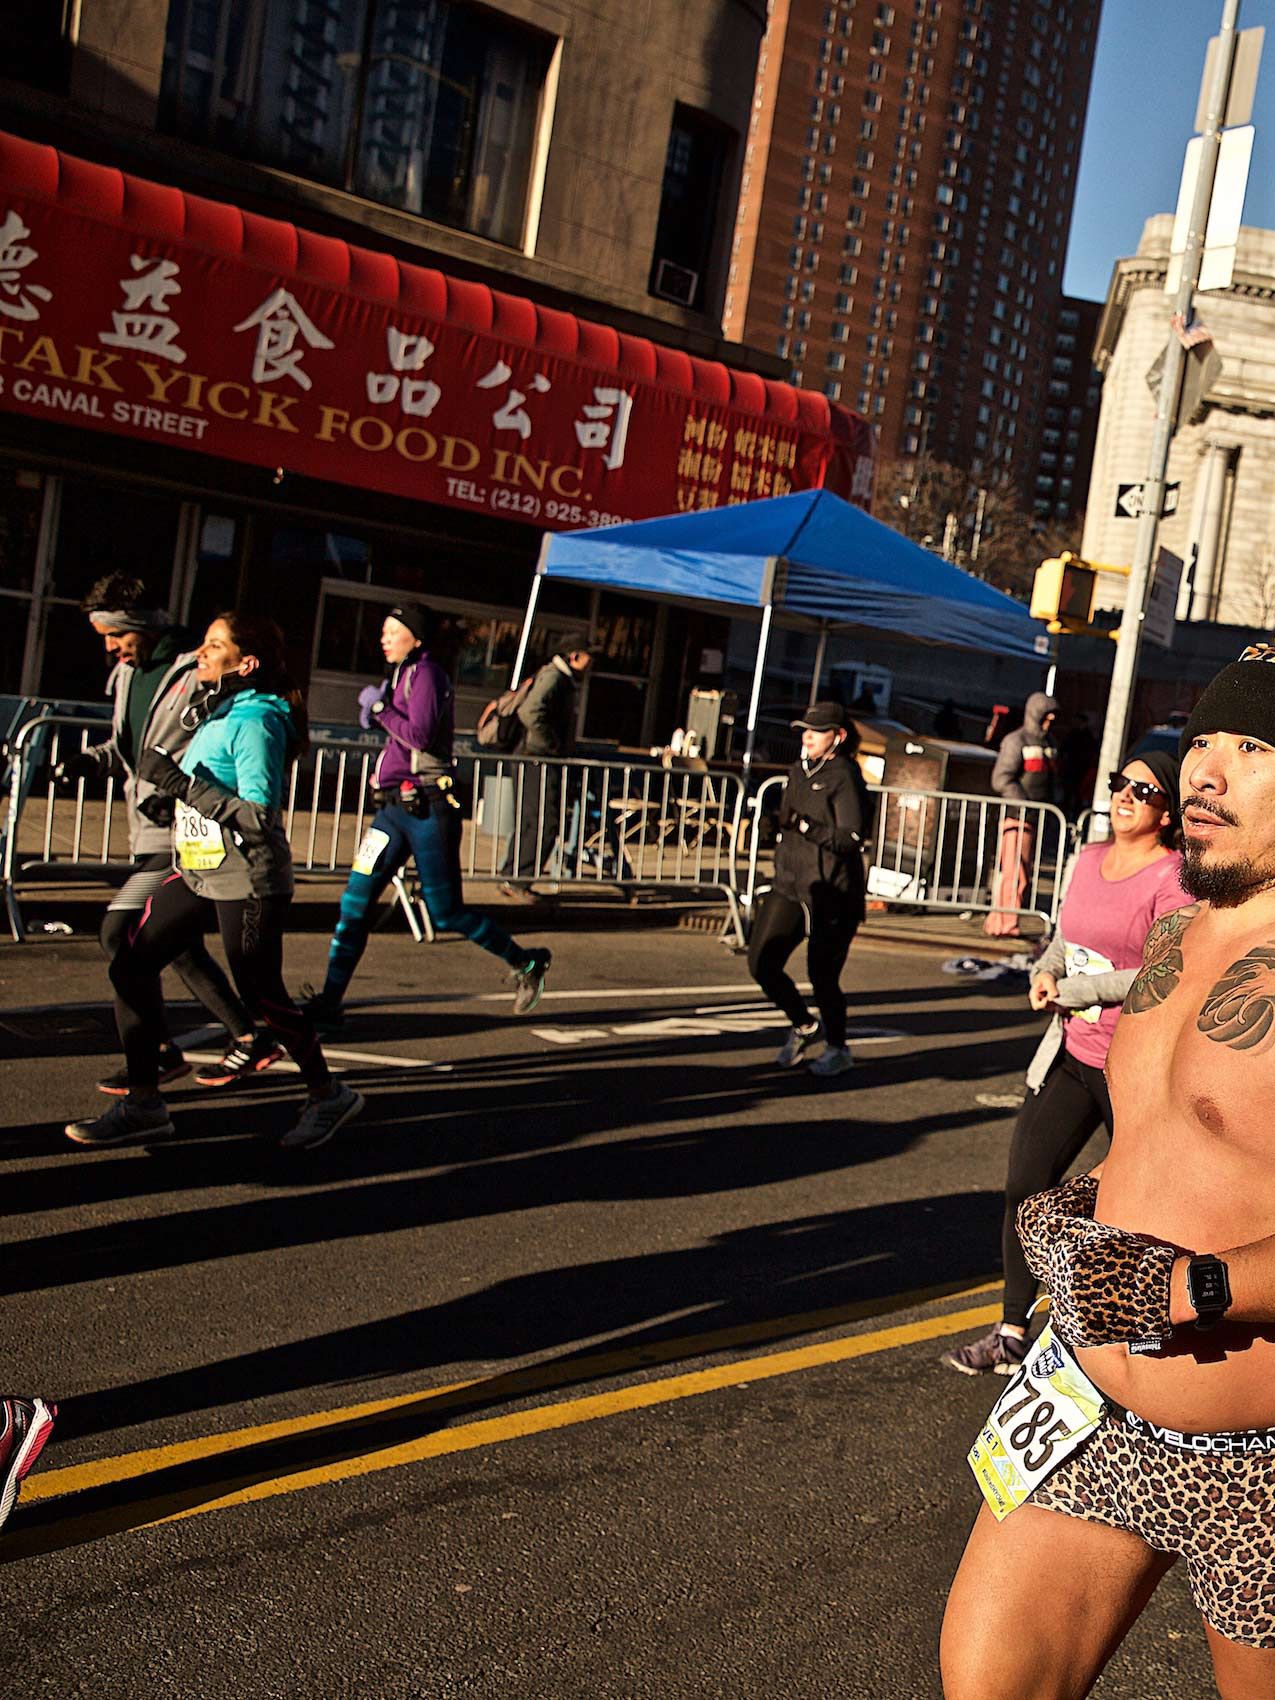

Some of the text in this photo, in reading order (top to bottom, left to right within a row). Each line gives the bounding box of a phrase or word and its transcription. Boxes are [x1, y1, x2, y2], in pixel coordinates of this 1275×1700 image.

[13, 379, 105, 419] CANAL
[112, 401, 210, 440] STREET
[136, 360, 300, 433] YICK
[315, 405, 481, 471] FOOD
[490, 450, 593, 501] INC.
[446, 478, 485, 504] TEL:
[490, 487, 541, 518] (212)
[982, 1428, 995, 1444] VE
